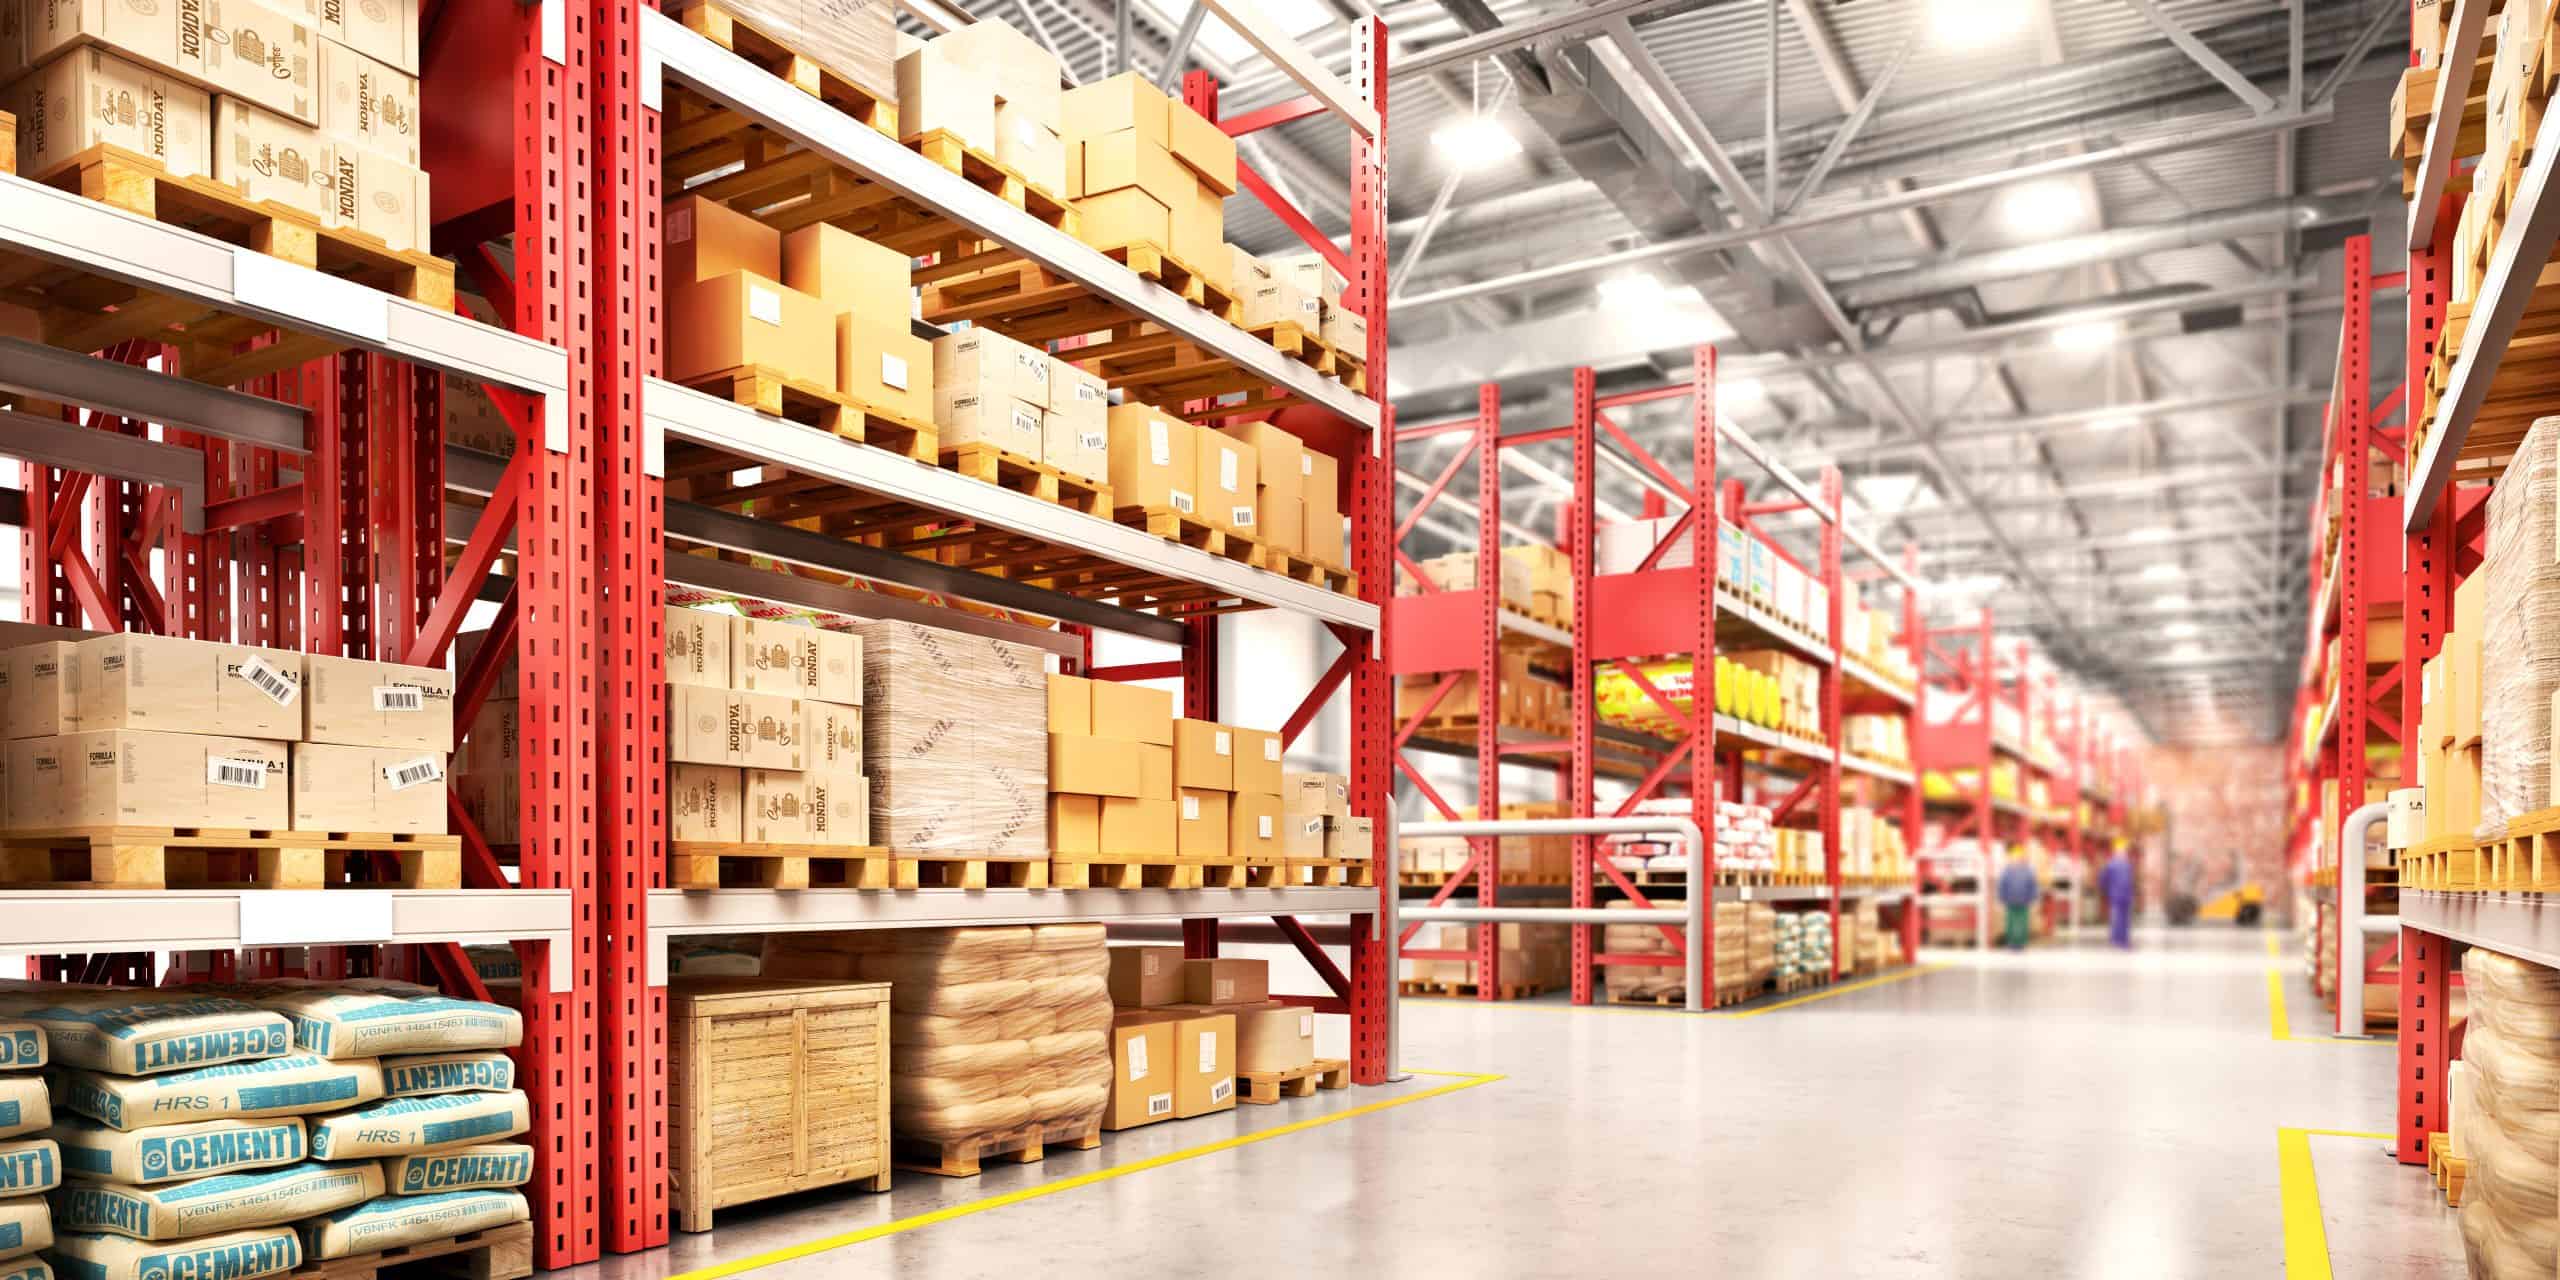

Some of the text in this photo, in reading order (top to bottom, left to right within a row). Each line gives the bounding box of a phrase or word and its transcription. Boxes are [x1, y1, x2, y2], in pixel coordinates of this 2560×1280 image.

[152, 89, 165, 156] MONDAY
[339, 156, 354, 219] MONDAY
[807, 641, 817, 687] MONDAY
[816, 786, 826, 832] MONDAY
[147, 1029, 266, 1068] CEMENT
[396, 1062, 492, 1092] CEMENT
[153, 1095, 229, 1113] HRS 1
[170, 1128, 290, 1172] CEMENT
[356, 1130, 416, 1144] HRS 1
[428, 1155, 522, 1187] CEMENT
[183, 1203, 235, 1218] VBNFK
[354, 1221, 397, 1236] VBNFK
